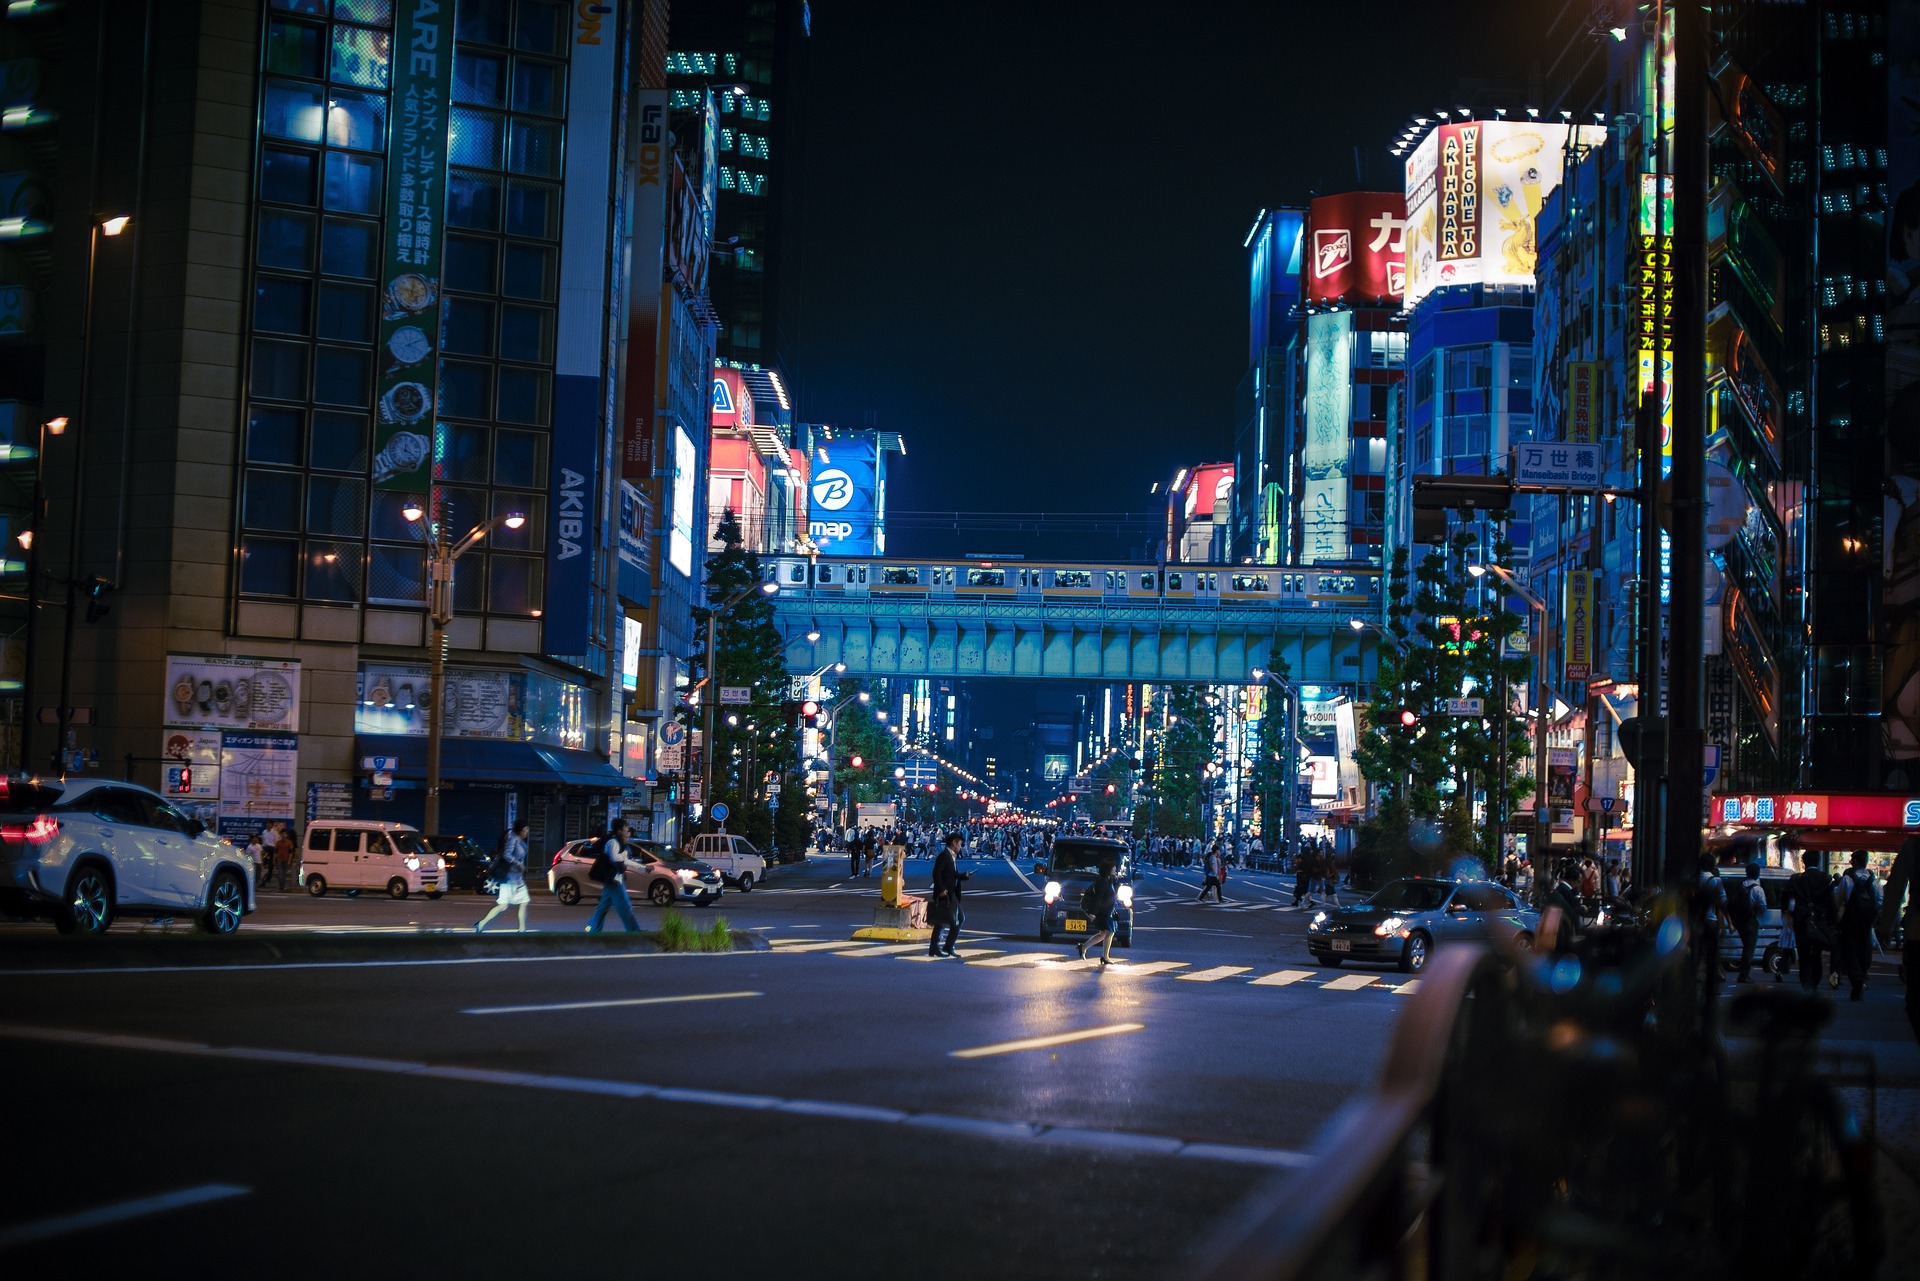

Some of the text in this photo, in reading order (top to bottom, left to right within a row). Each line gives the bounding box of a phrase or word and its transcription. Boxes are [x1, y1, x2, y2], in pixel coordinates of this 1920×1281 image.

[396, 83, 420, 263] 人気ブランド多数取り揃え
[413, 87, 439, 266] メンズ・レディース腕時計
[1444, 139, 1457, 256] AKIHABARA
[1462, 128, 1476, 254] WELCOME TO
[1369, 212, 1405, 253] カ
[1645, 236, 1673, 250] ゲム
[627, 439, 636, 462] Store
[634, 417, 643, 462] Electronics
[641, 438, 650, 462] Home
[1524, 449, 1595, 468] 万世橋
[1521, 469, 1597, 483] Manseibashi Bridge
[557, 467, 585, 561] AKIBA
[1573, 595, 1586, 625] TAX
[1574, 625, 1585, 661] FREE
[407, 668, 474, 678] WATC QUARE
[225, 737, 253, 745] エディオン
[376, 758, 384, 766] 17
[1603, 798, 1613, 809] 17
[1785, 801, 1817, 820] 2号館
